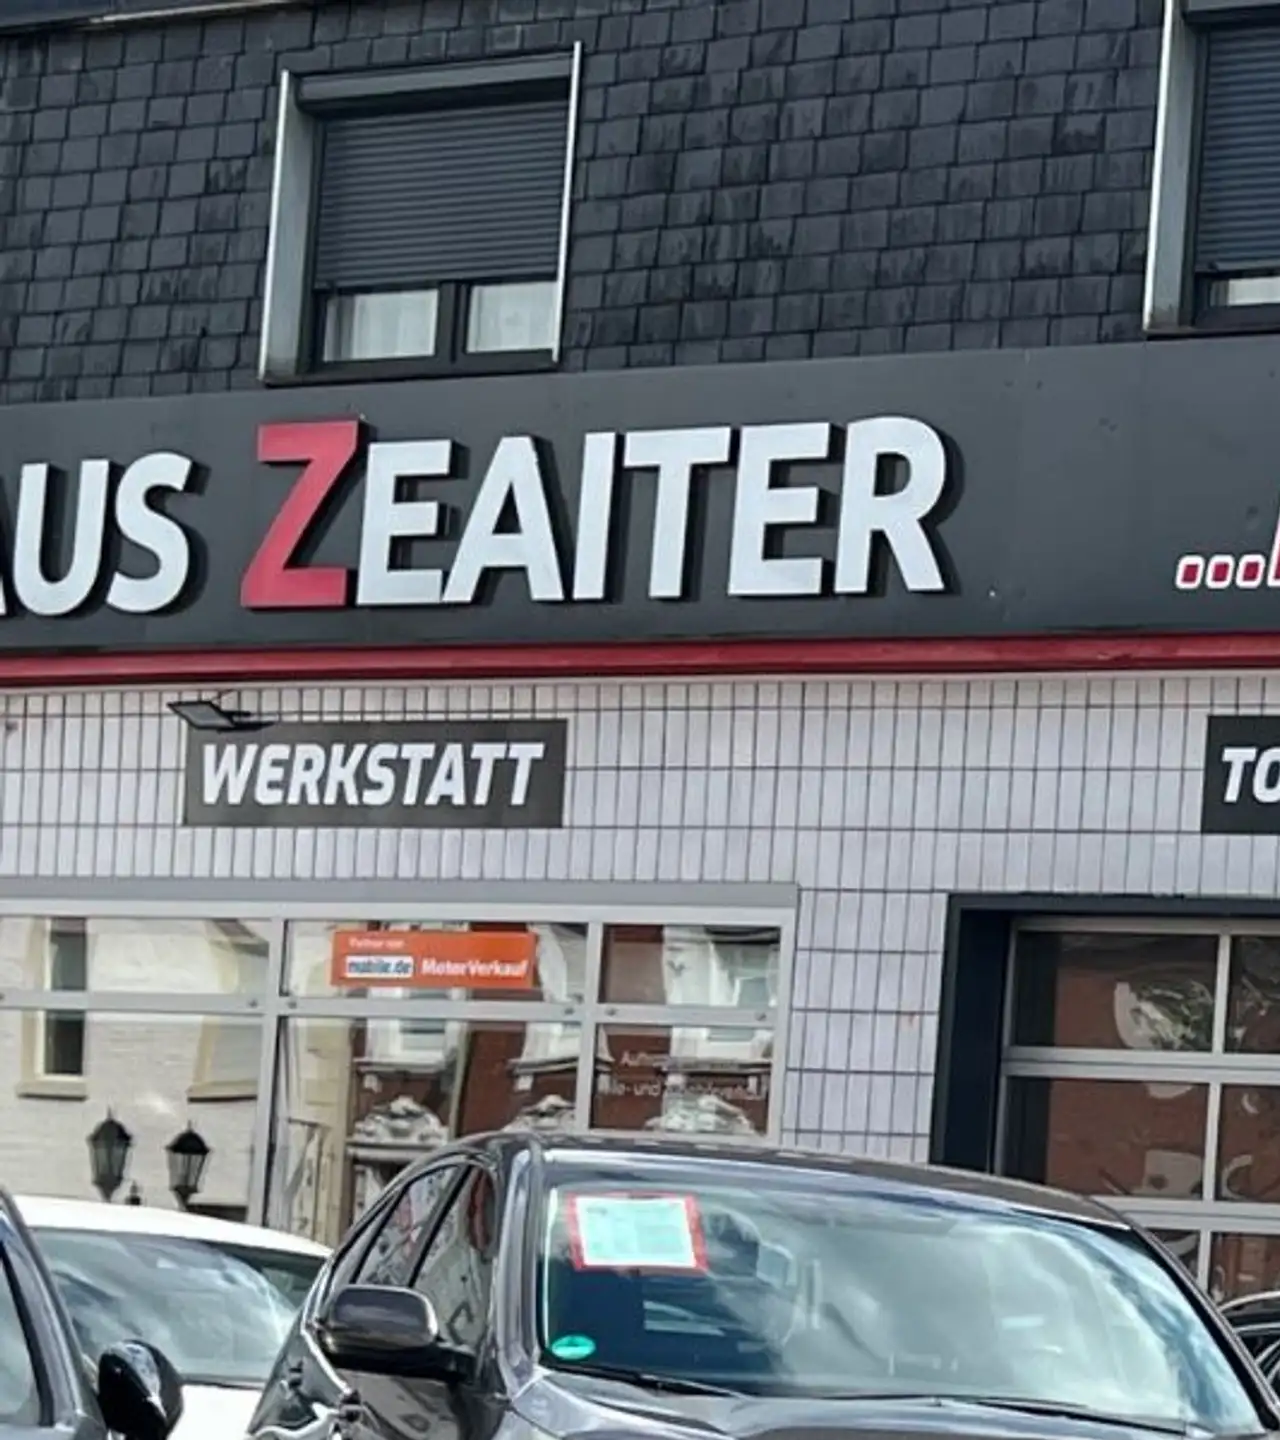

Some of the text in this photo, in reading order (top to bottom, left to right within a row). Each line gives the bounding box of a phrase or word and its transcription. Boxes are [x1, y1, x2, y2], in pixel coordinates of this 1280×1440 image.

[0, 414, 947, 617] US ZEAITER
[201, 742, 545, 807] WERKSTATT
